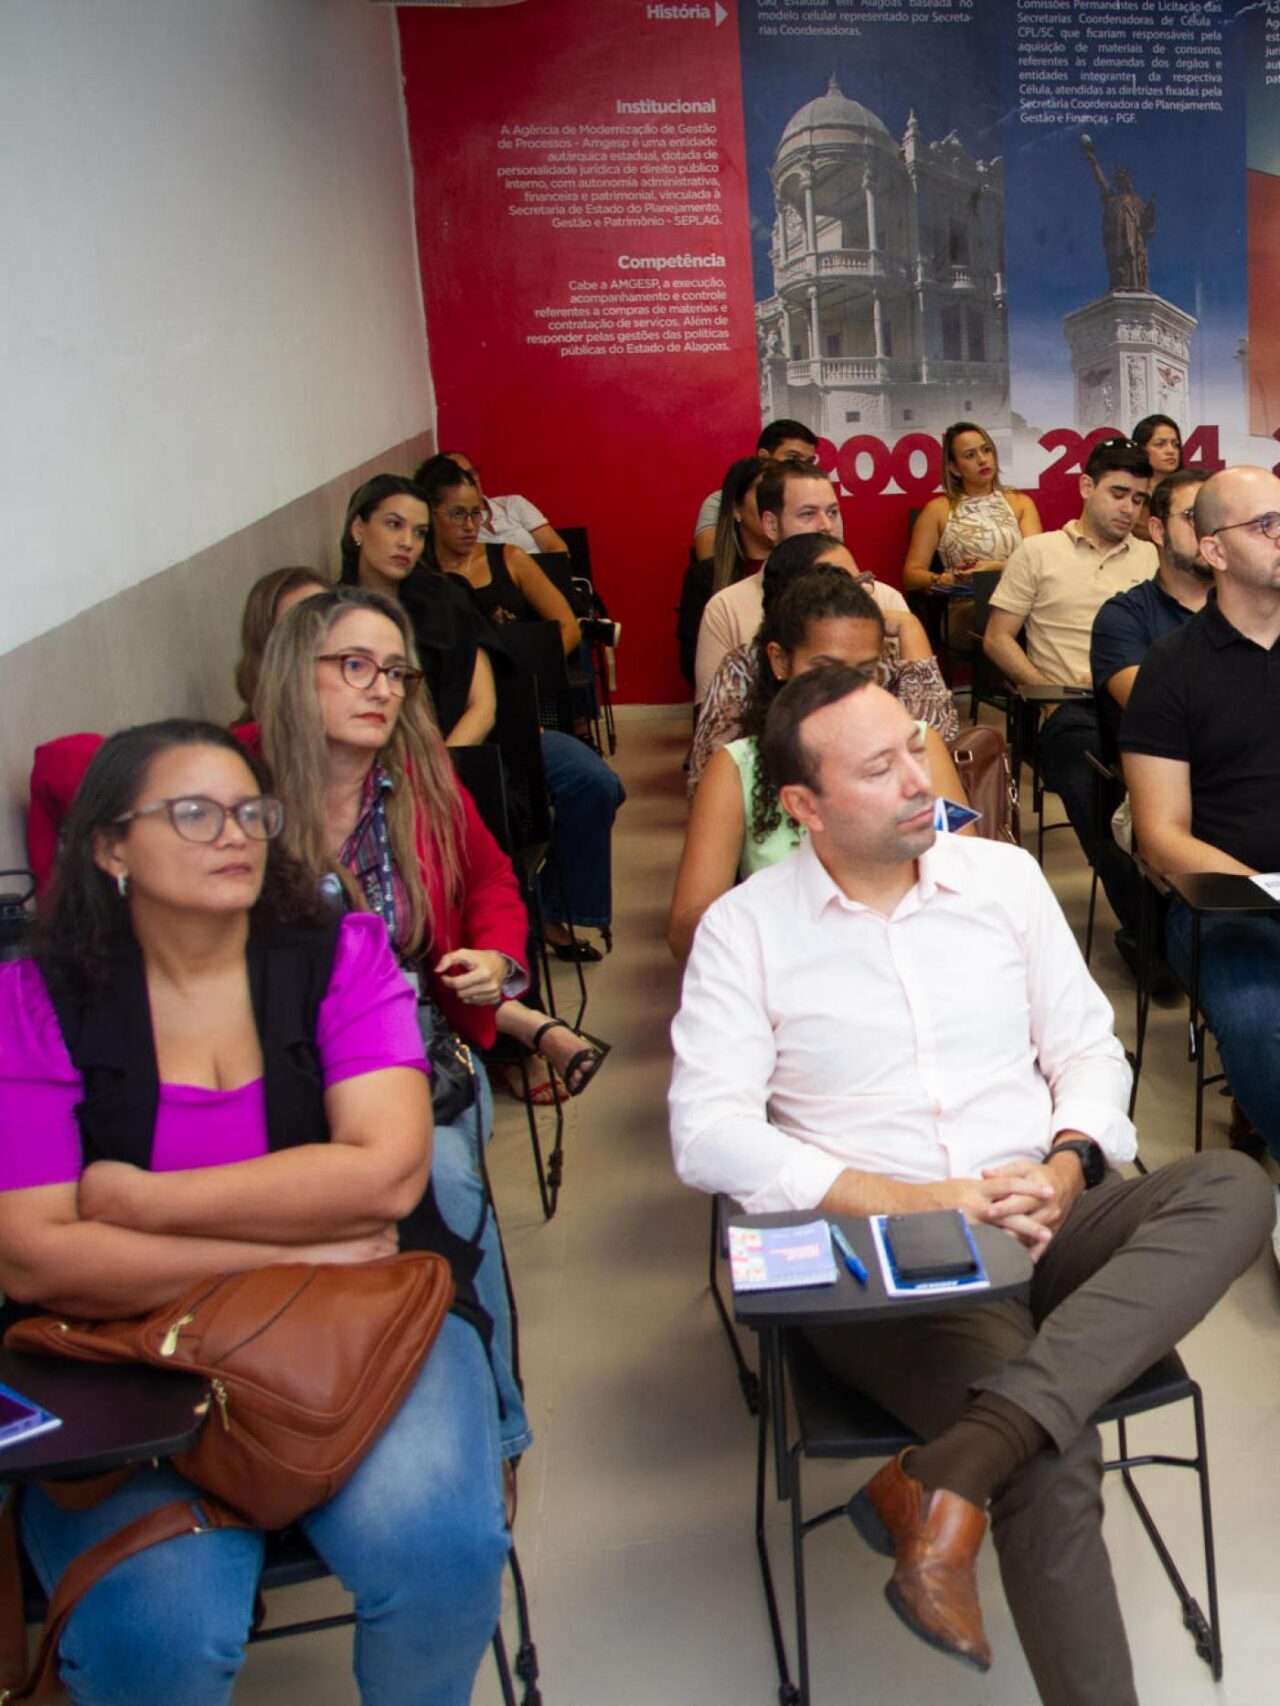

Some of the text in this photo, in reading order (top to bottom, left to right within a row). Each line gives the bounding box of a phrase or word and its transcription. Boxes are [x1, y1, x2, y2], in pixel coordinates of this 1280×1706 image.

[647, 4, 711, 19] História
[616, 99, 716, 114] Institucional
[618, 253, 726, 271] Competência
